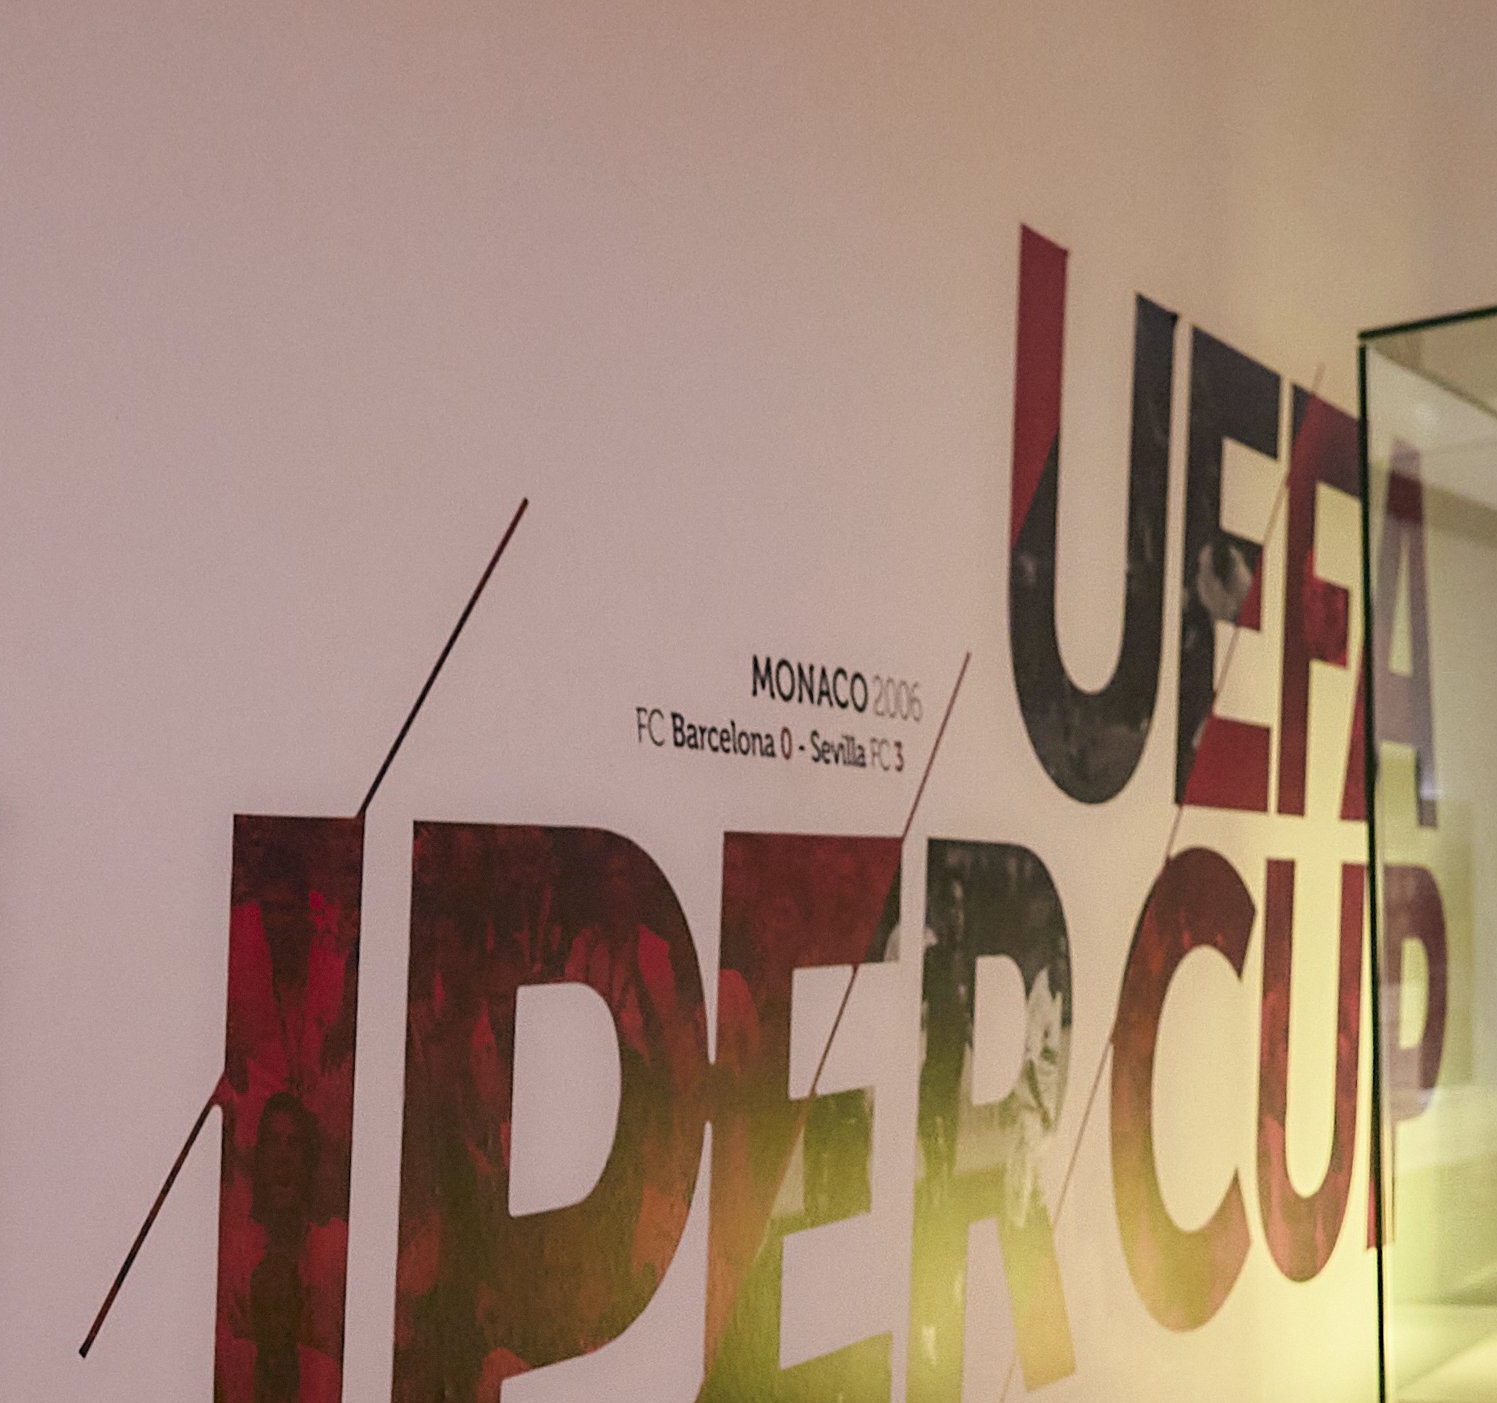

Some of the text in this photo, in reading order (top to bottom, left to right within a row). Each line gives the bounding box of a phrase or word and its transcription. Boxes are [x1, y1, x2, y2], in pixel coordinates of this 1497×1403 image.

[1009, 222, 1438, 829] UEFA
[635, 706, 665, 747] FC
[670, 711, 776, 758] Barcelona
[780, 726, 793, 760] 0
[810, 729, 867, 768] Sevilla
[870, 738, 891, 772] FC
[894, 740, 906, 773] 3
[752, 654, 924, 722] MONACO 2006
[1110, 846, 1447, 1333] CUP
